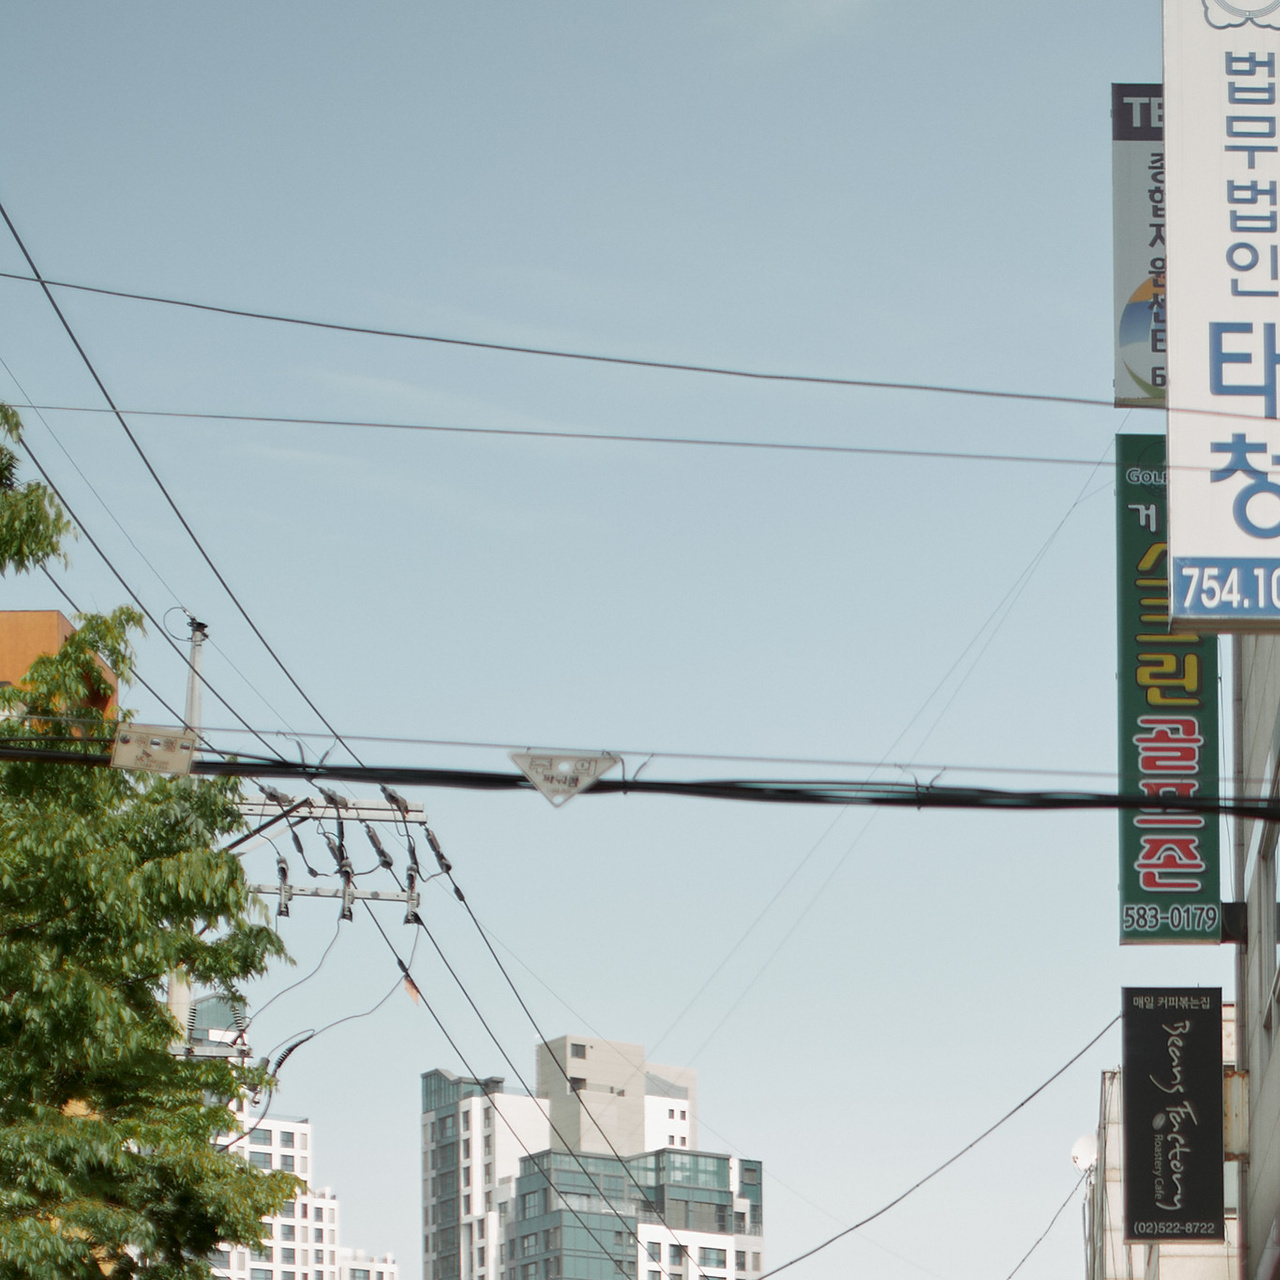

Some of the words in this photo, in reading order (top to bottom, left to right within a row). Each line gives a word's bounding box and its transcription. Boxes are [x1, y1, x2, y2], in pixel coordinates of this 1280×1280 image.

[1223, 50, 1279, 298] 법무법인
[1132, 715, 1206, 892] 골프존
[1122, 903, 1218, 932] 583-0179
[1132, 996, 1155, 1010] 매일
[1157, 996, 1211, 1010] 커피볶는집
[1149, 1020, 1191, 1094] Beans
[1153, 1134, 1164, 1175] Roastery
[1133, 1221, 1215, 1235] (02)522-8722
